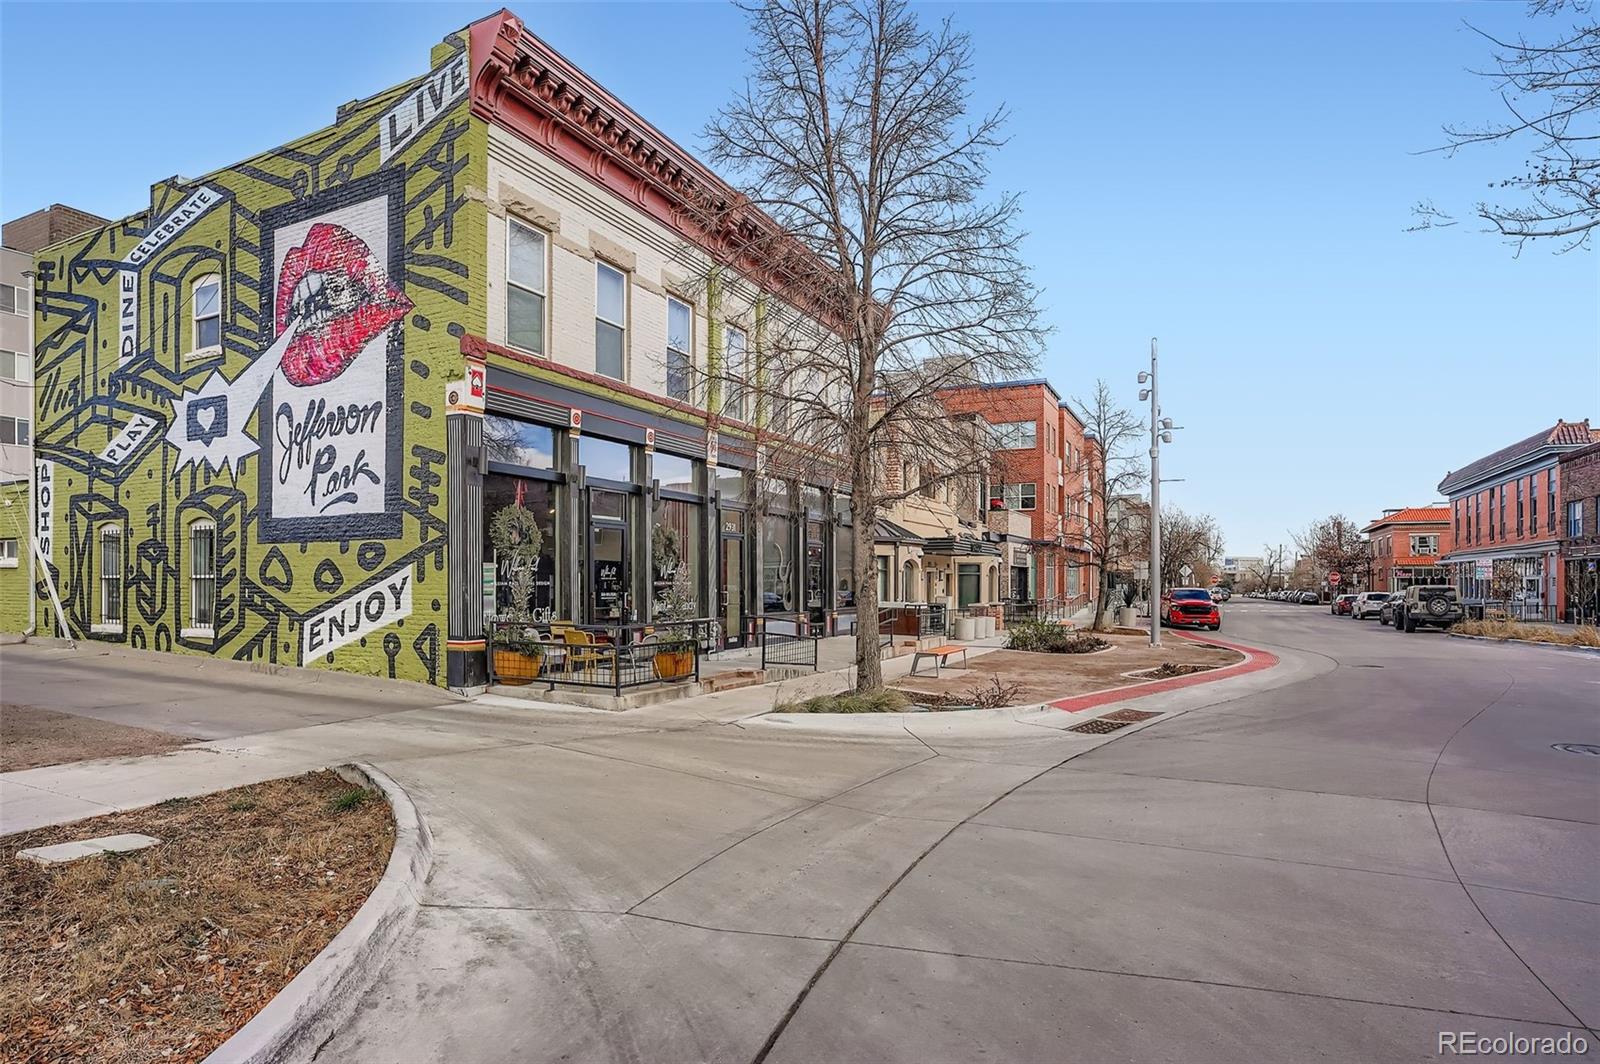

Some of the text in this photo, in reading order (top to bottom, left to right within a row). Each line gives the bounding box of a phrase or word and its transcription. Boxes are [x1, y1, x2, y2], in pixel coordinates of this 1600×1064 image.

[388, 57, 465, 152] LIVE
[130, 192, 212, 264] CELEBRATE
[121, 275, 134, 358] DINE
[106, 417, 151, 462] PLAY
[276, 398, 383, 485] Jefferson
[303, 444, 381, 507] Park
[40, 463, 51, 555] SHOP
[309, 575, 410, 652] ENJOY
[532, 606, 558, 624] Gifts
